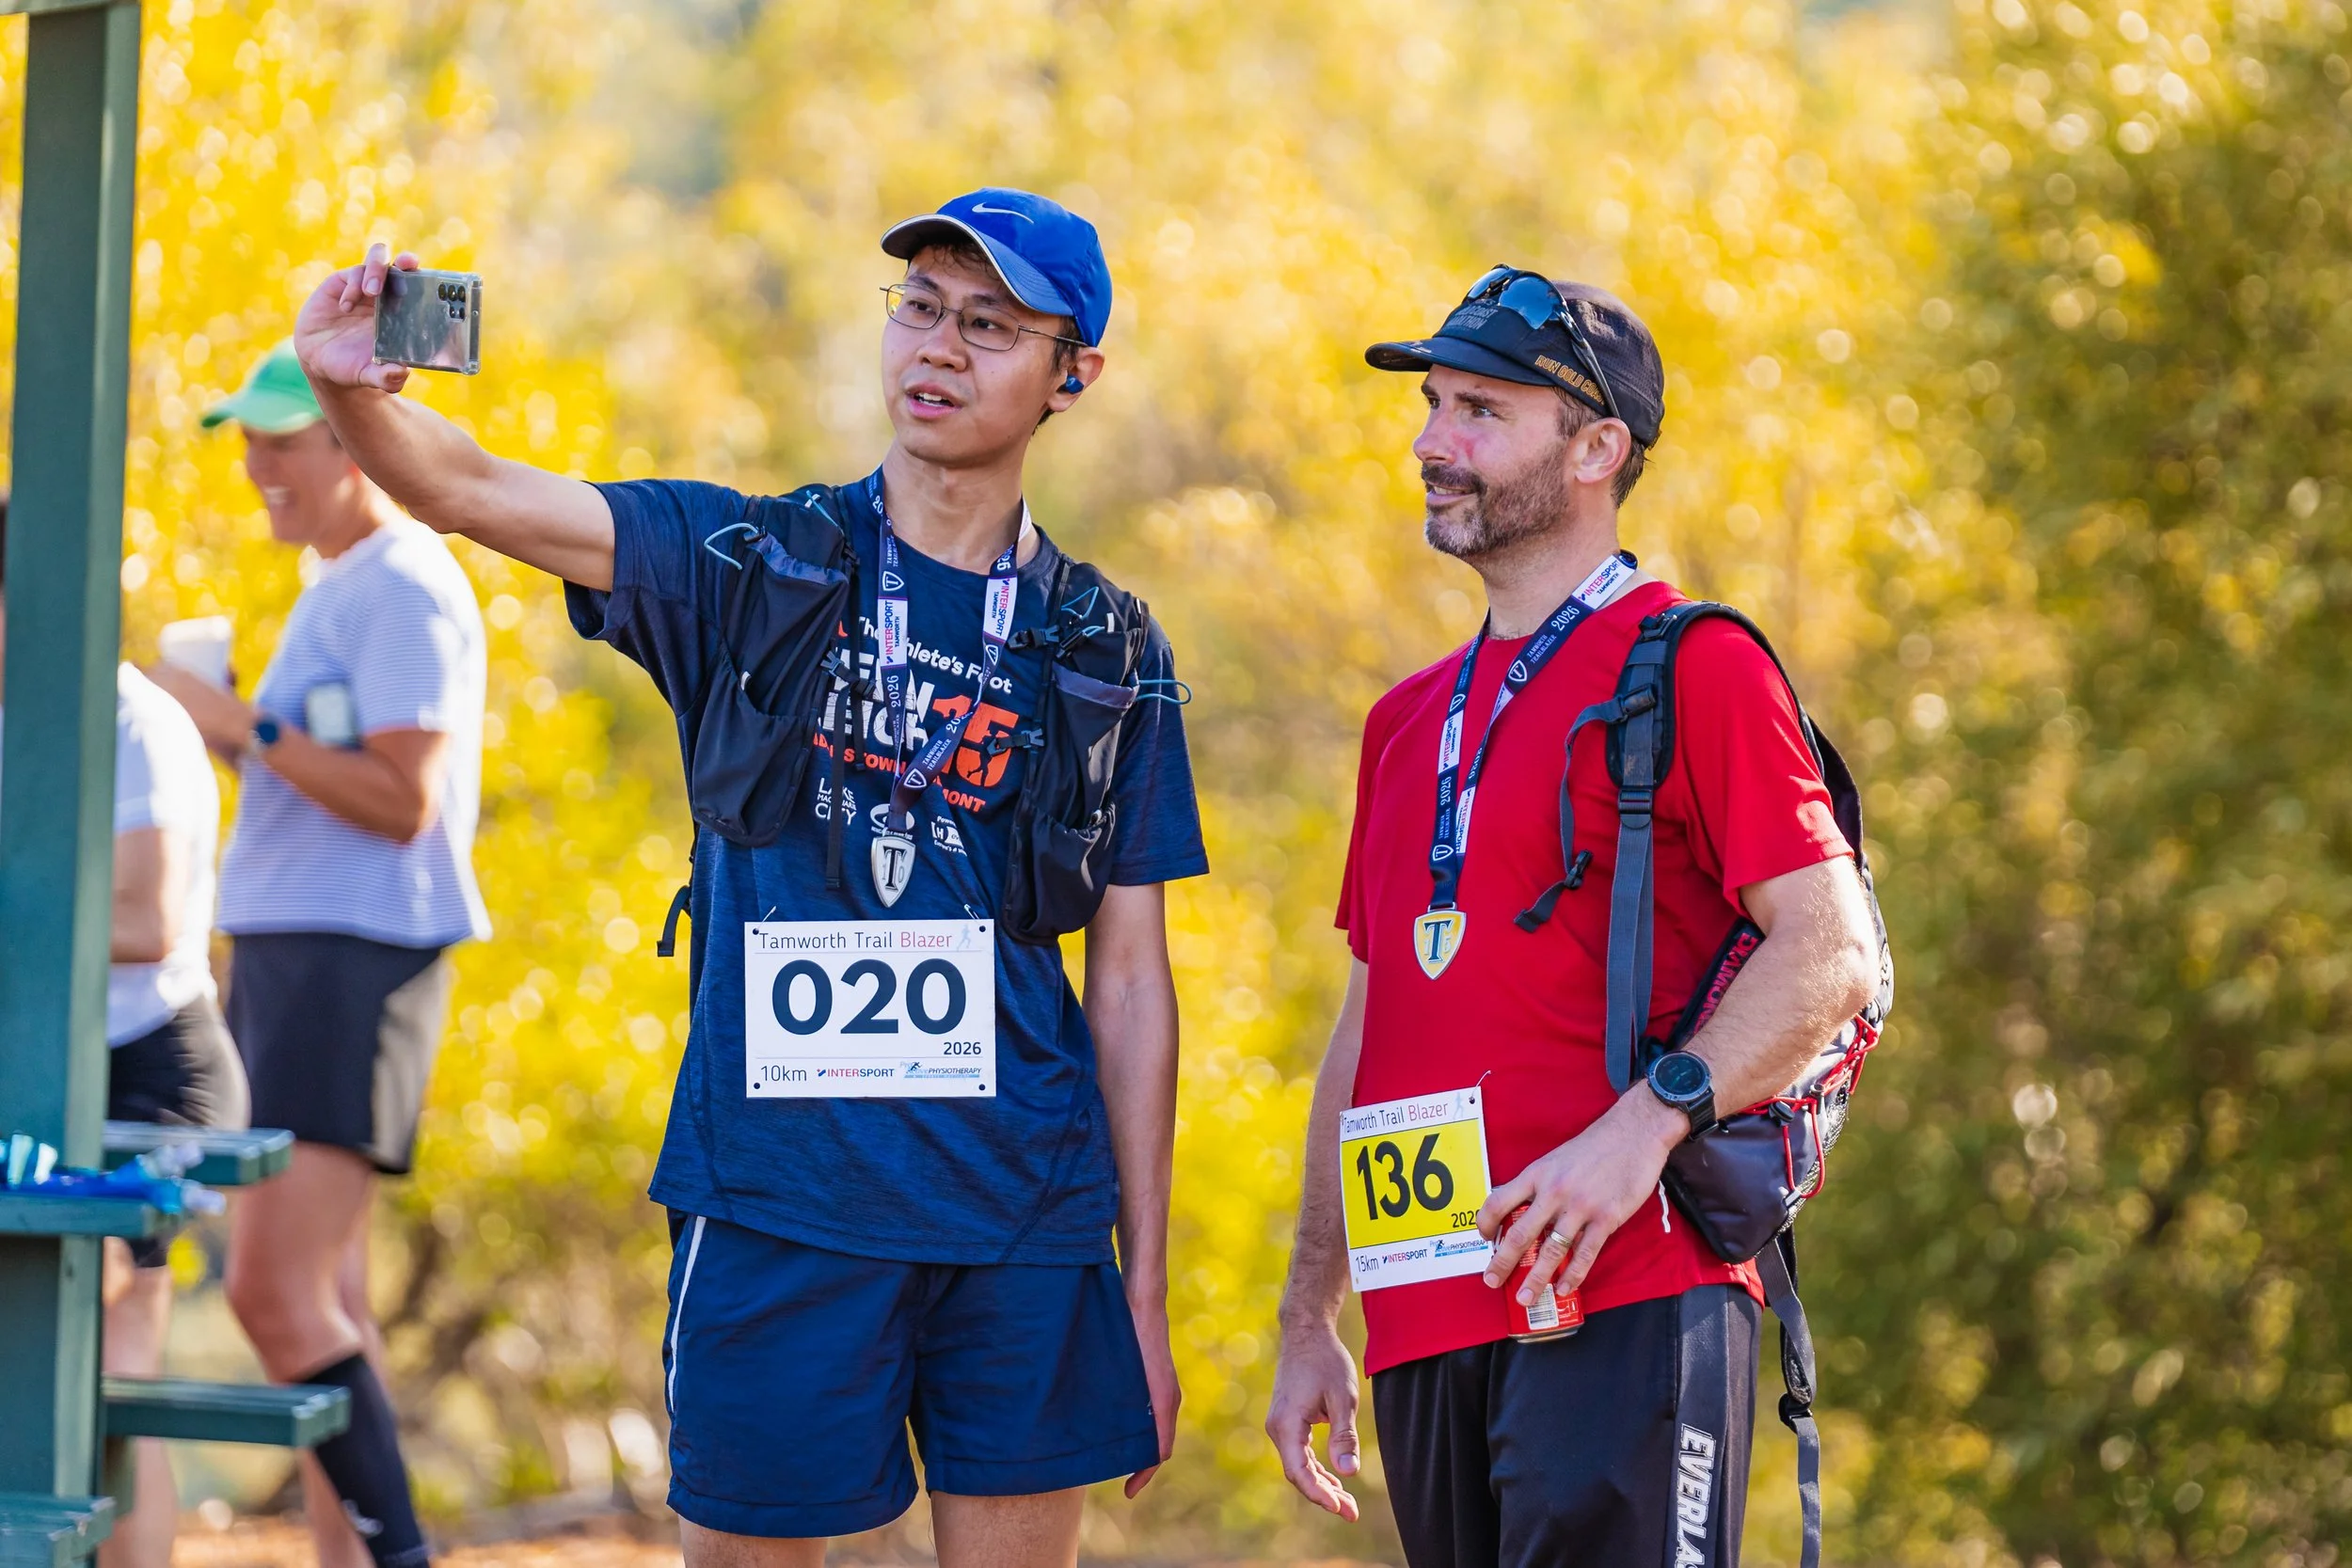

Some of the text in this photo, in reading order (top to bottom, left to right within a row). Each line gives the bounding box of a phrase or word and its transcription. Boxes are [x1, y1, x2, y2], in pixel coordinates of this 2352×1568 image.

[1534, 355, 1605, 406] RUN GOLD COAS
[995, 585, 1010, 638] INTERSPORT
[1550, 605, 1581, 632] 2026
[884, 600, 895, 656] INTERSPORT
[886, 674, 901, 708] 2026
[1440, 776, 1453, 806] 2026
[758, 931, 953, 949] Tamworth Trail Blazer
[771, 958, 966, 1036] 020
[943, 1041, 982, 1055] 2026
[760, 1065, 895, 1082] 10km INTERSPORT
[1379, 1106, 1406, 1127] Trail
[1407, 1102, 1449, 1122] Blazer
[1356, 1132, 1454, 1221] 136
[1355, 1255, 1380, 1273] 15km
[1388, 1249, 1428, 1264] INTERSPORT
